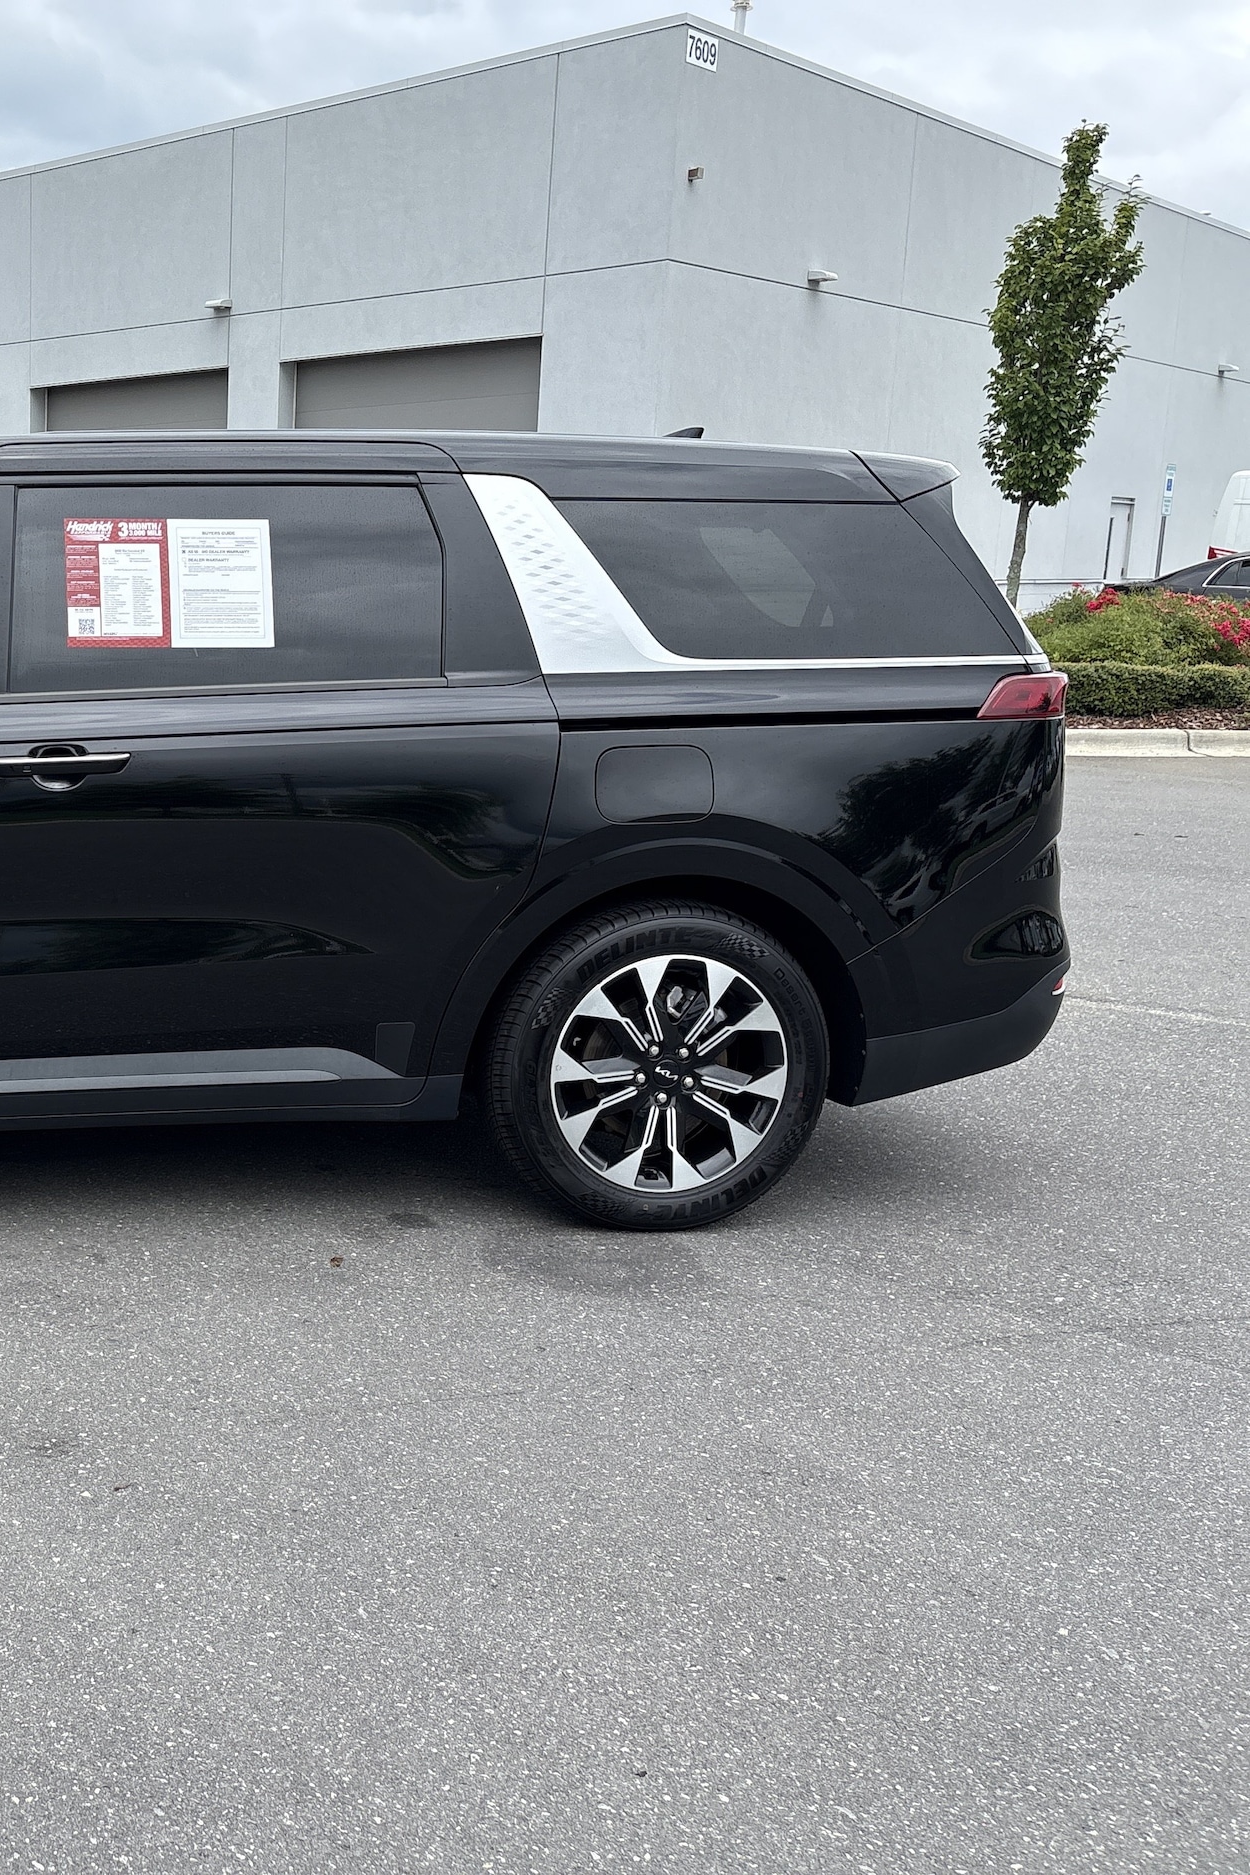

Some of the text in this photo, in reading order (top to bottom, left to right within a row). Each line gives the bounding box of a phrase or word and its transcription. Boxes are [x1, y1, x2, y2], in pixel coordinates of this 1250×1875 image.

[689, 34, 717, 66] 7609
[117, 522, 129, 537] 3
[577, 926, 696, 983] DELINTE
[657, 1164, 768, 1222] DELINTE
